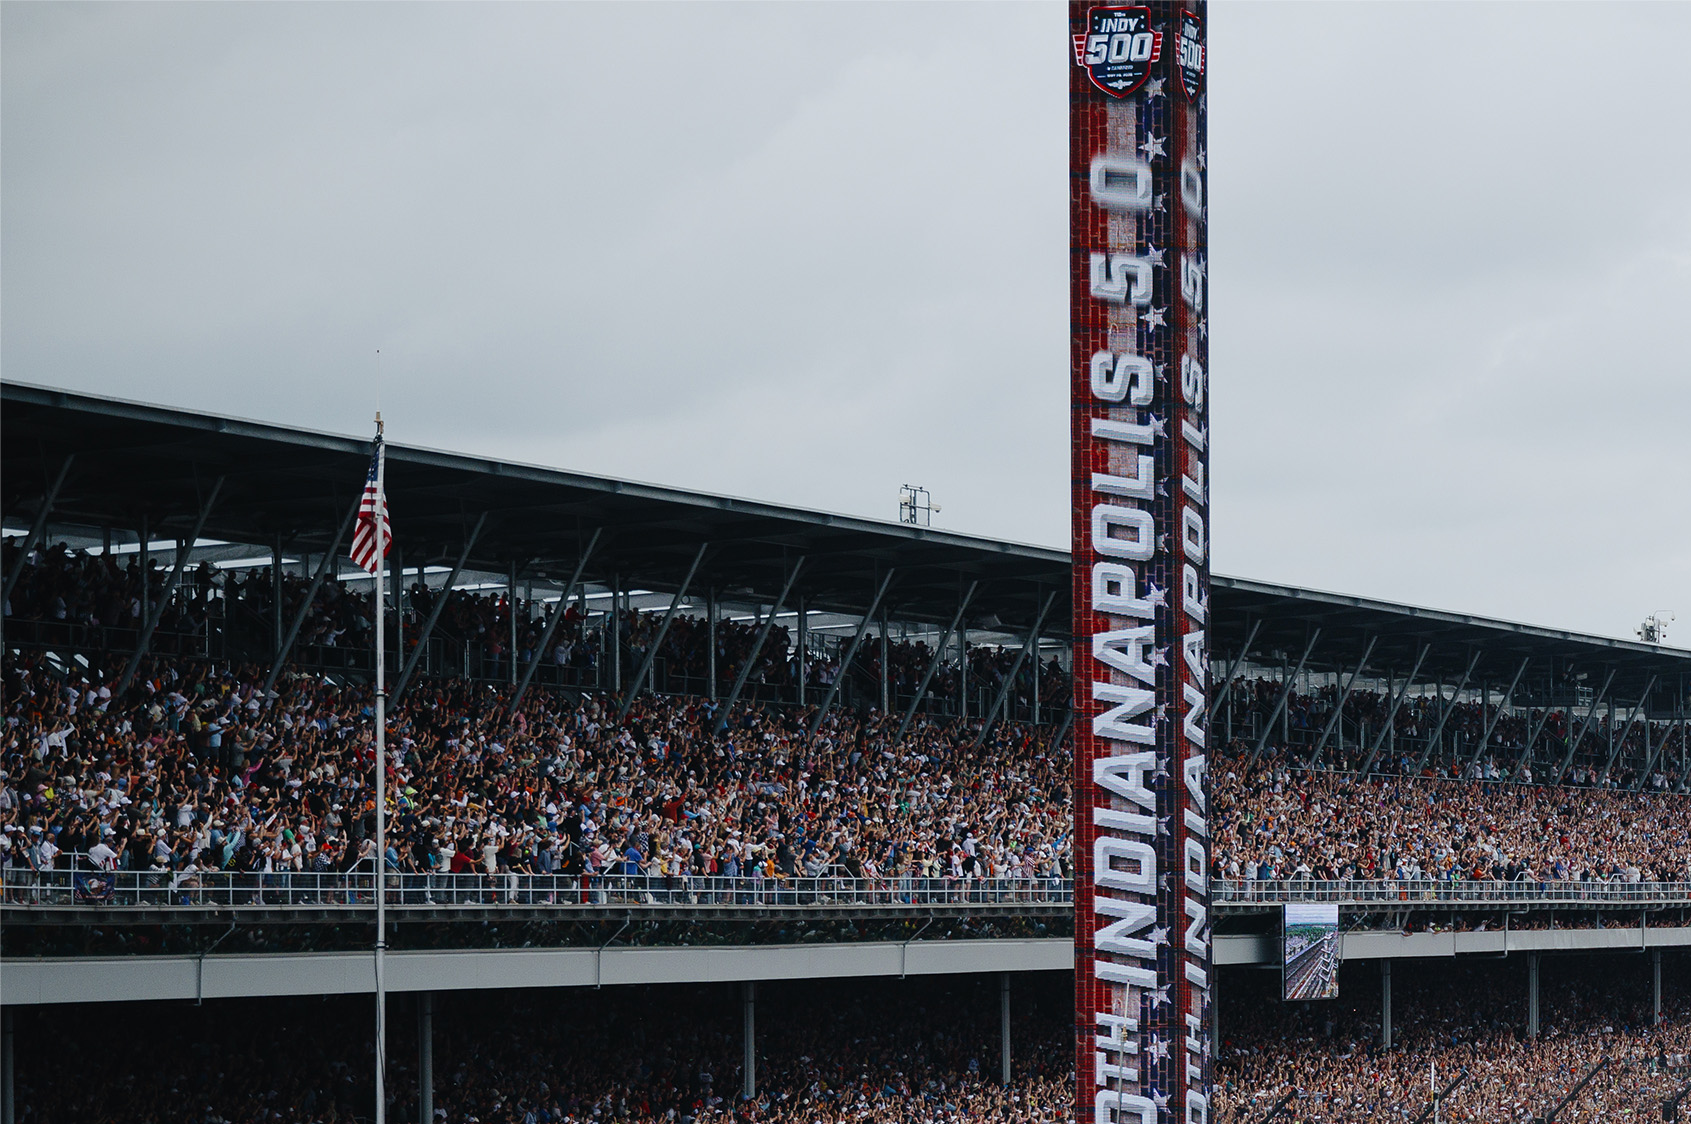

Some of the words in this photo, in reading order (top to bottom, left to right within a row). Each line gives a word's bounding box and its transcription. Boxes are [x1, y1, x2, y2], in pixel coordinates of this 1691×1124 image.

[1100, 18, 1139, 33] INDY
[1085, 32, 1154, 65] 500
[1180, 36, 1203, 72] 500
[1090, 352, 1159, 989] INDIANAPOLIS
[1180, 352, 1209, 989] INDIANAPOLIS
